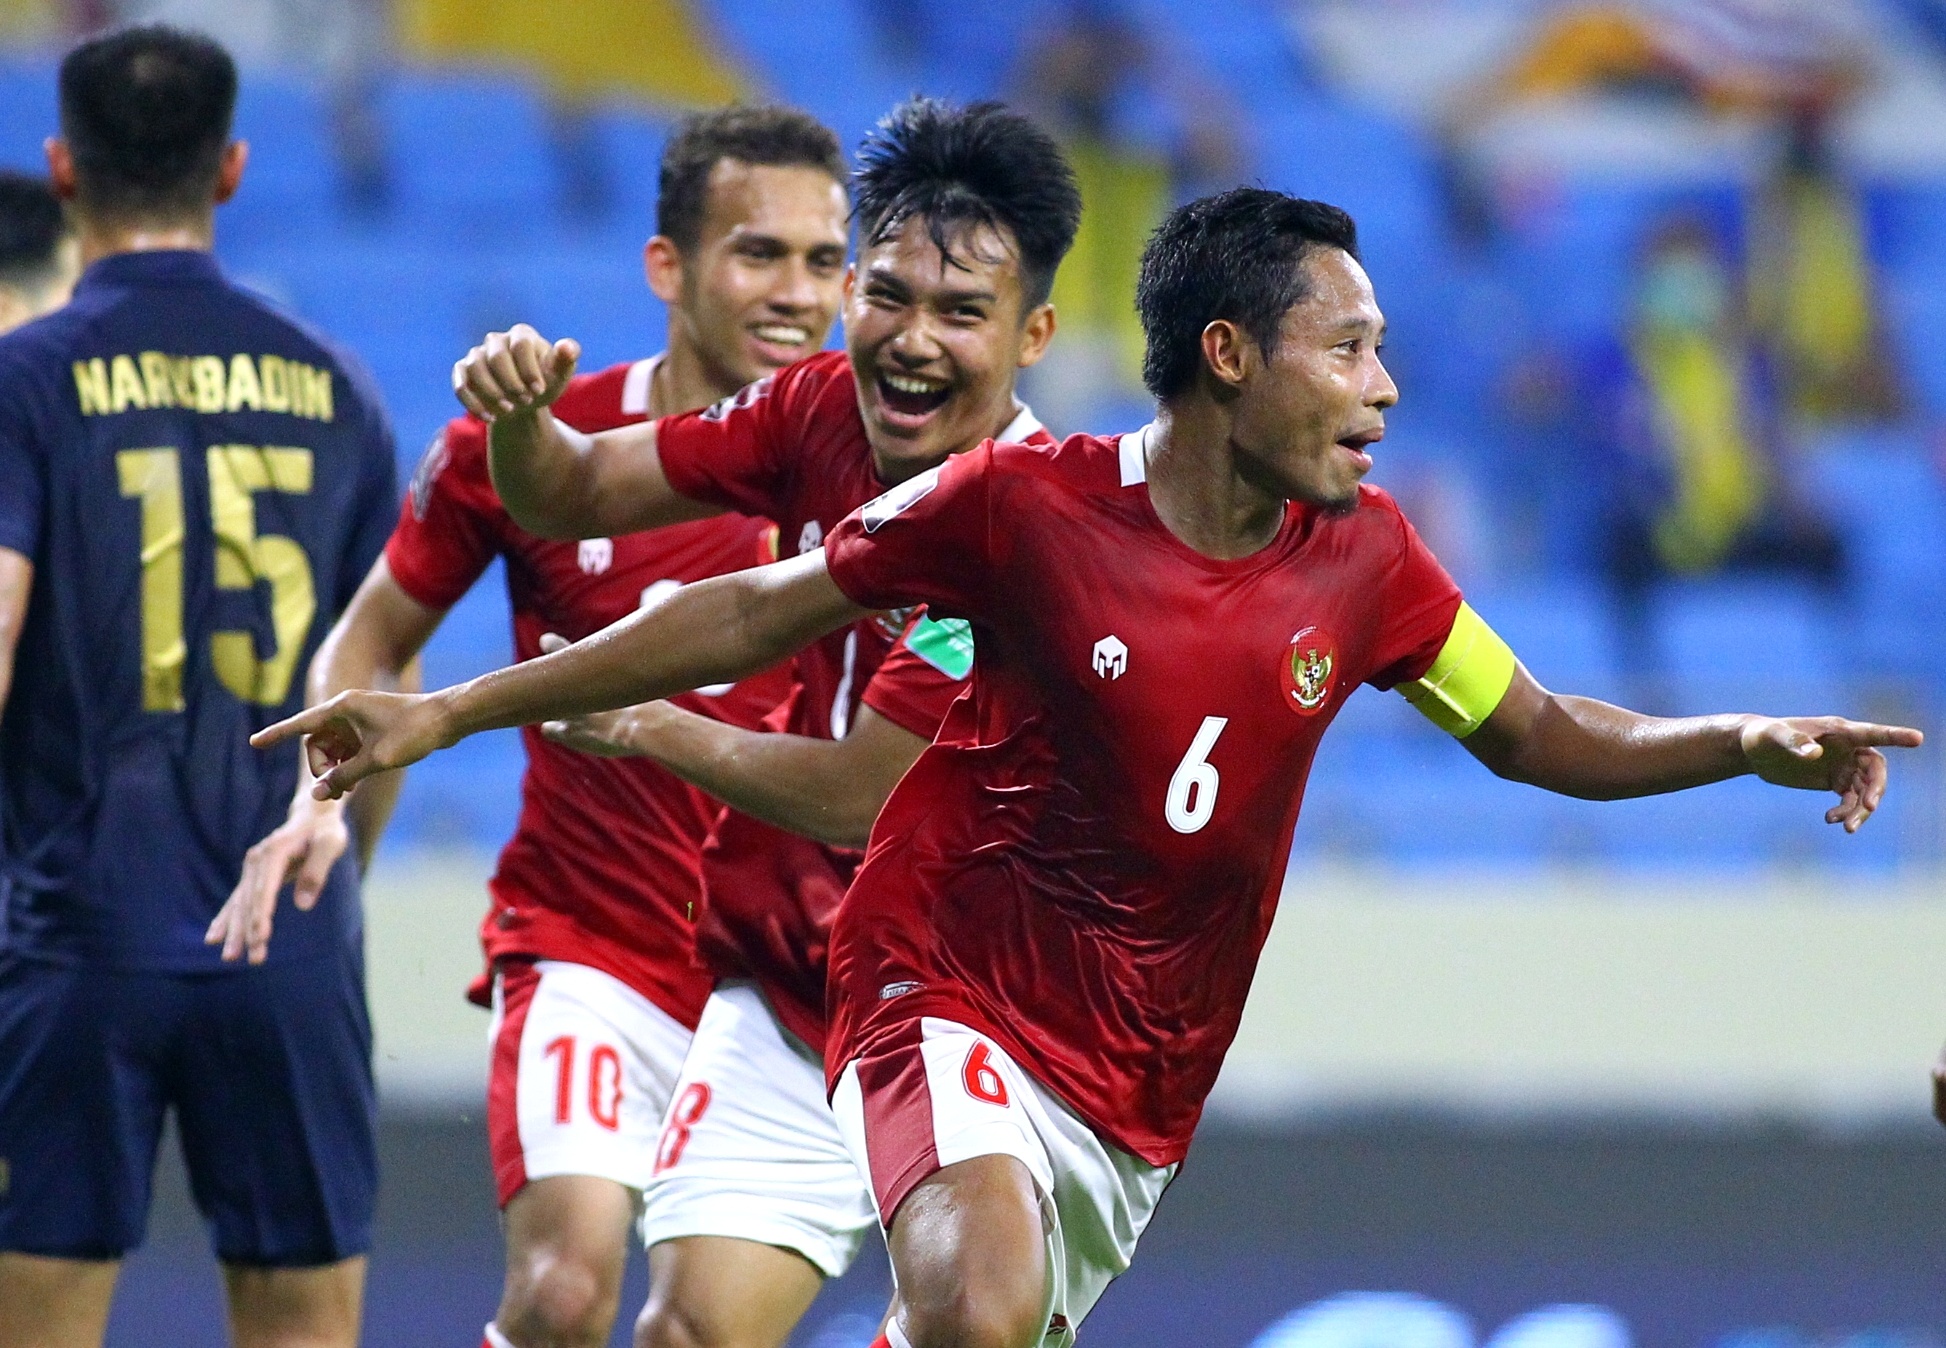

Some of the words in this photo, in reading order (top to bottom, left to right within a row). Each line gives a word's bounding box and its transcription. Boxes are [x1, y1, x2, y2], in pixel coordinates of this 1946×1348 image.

[116, 444, 317, 712] 15
[1165, 715, 1228, 834] 6
[542, 1035, 624, 1132] 10
[961, 1038, 1010, 1108] 6
[652, 1081, 711, 1176] 8
